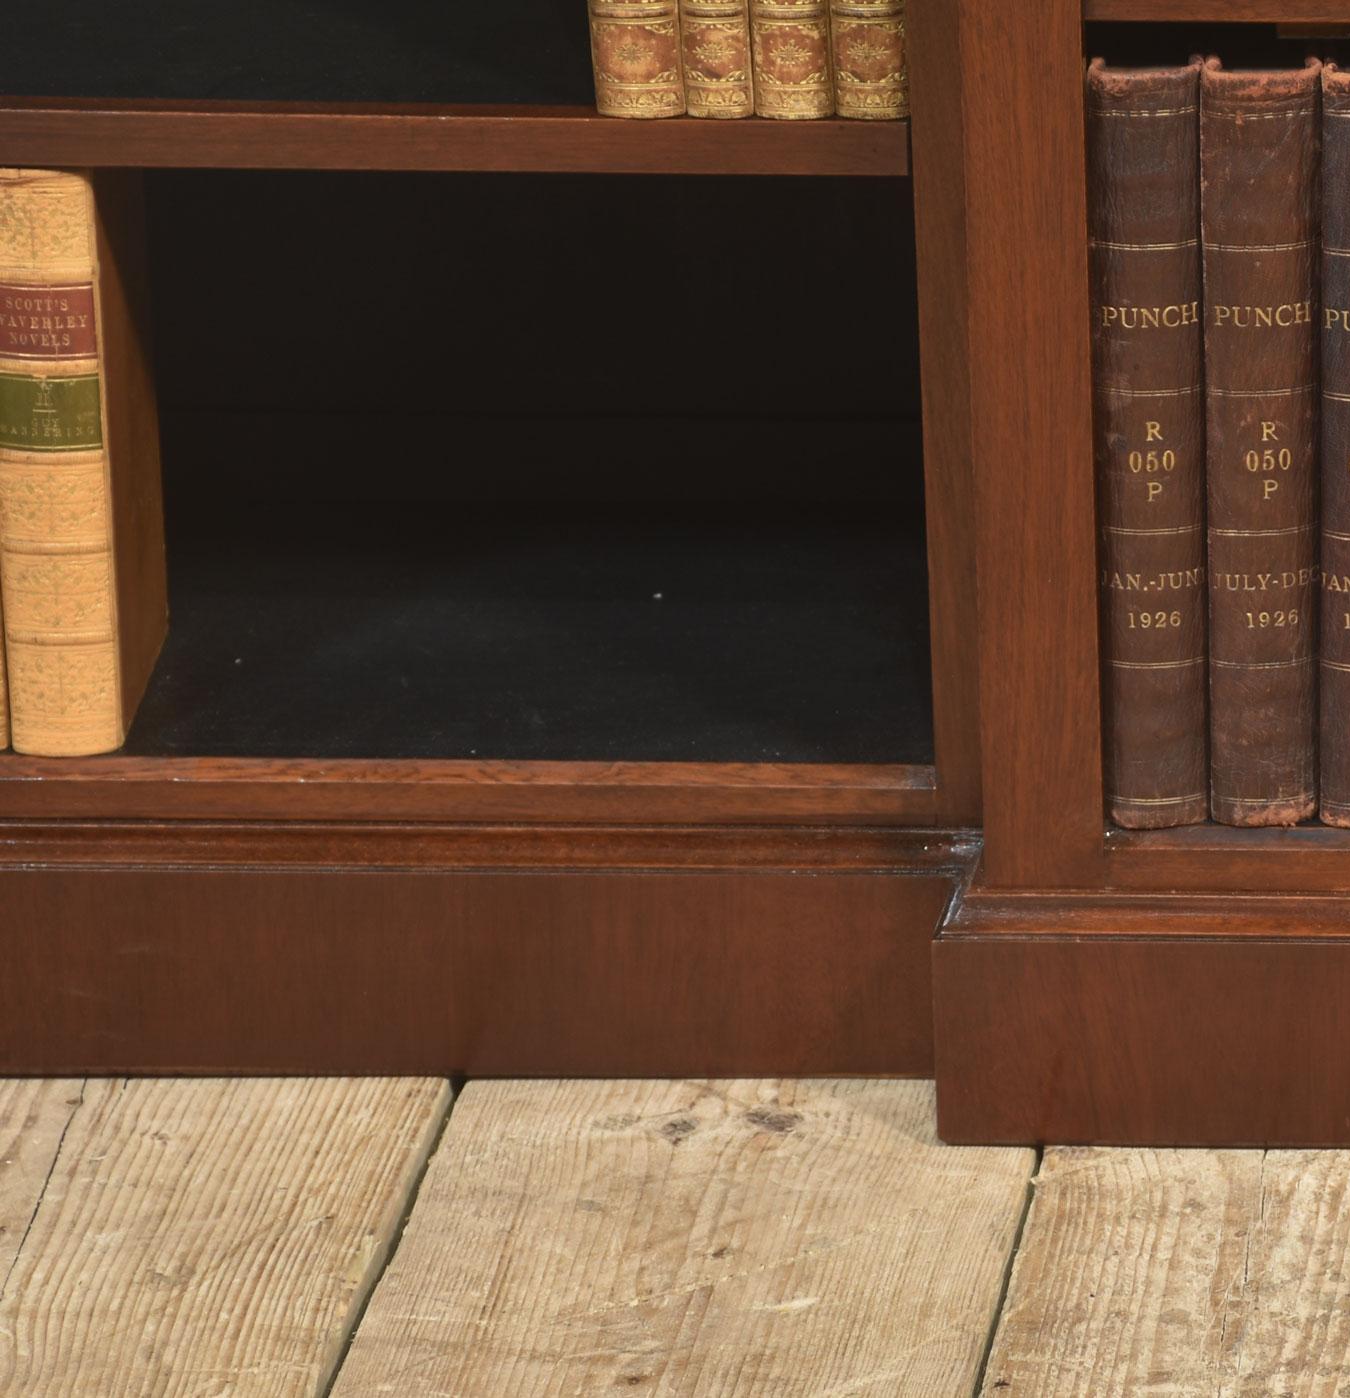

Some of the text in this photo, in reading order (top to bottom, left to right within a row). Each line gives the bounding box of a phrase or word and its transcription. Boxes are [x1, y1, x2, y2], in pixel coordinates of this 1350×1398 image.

[1101, 301, 1198, 329] PUNCH
[1214, 302, 1312, 327] PUNCH
[9, 332, 71, 347] NOVELS
[1146, 421, 1163, 441] R
[1261, 421, 1279, 441] R
[1129, 450, 1175, 473] 050
[1246, 449, 1292, 472] 050
[1146, 482, 1162, 502] P
[1263, 479, 1278, 500] P
[1128, 611, 1181, 629] 1926
[1246, 609, 1298, 629] 1926
